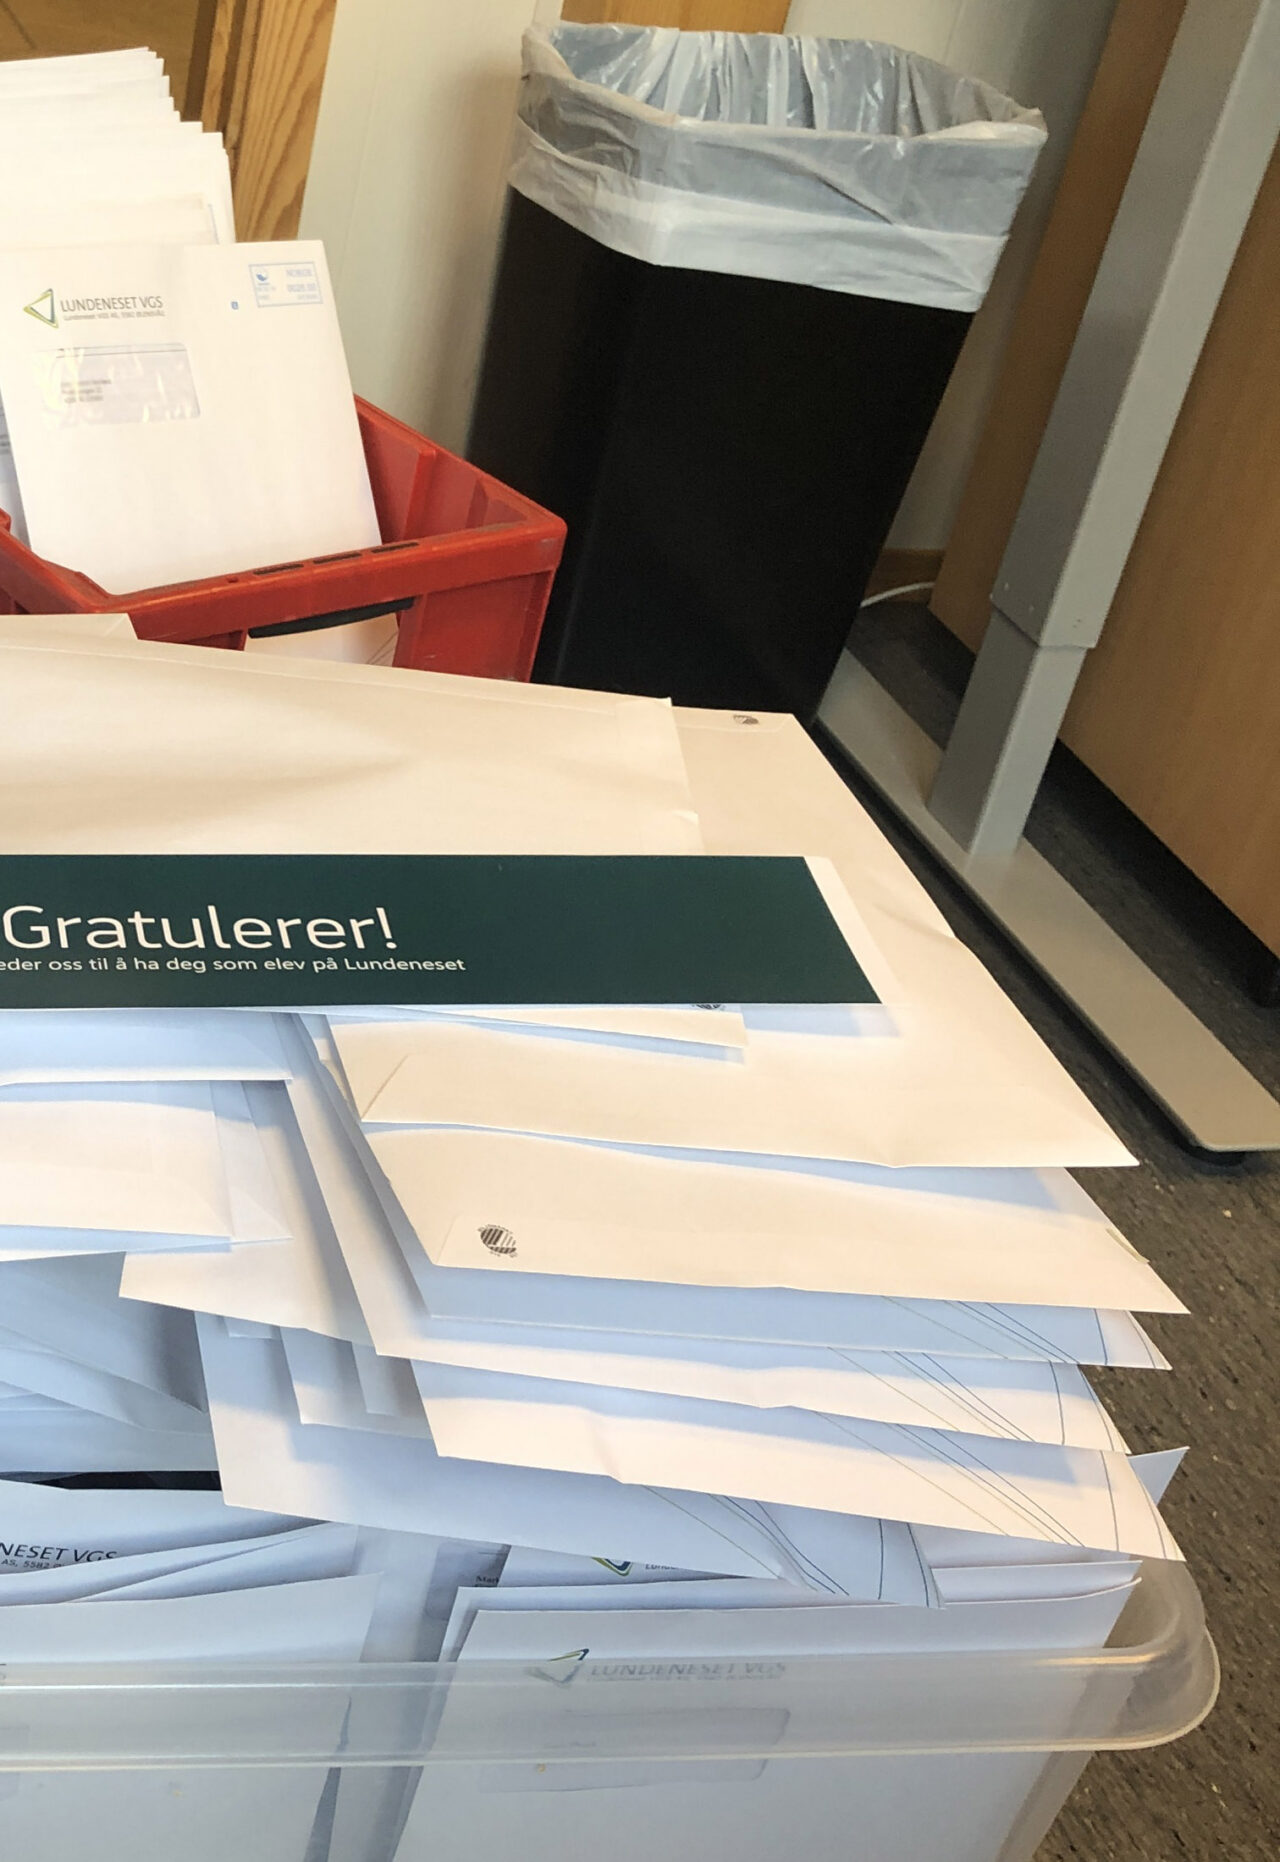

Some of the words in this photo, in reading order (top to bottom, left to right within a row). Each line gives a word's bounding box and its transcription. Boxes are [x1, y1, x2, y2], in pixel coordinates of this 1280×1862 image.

[60, 297, 138, 312] LUNDENESET
[138, 296, 164, 309] VGS
[2, 905, 397, 949] Gratulerer!
[48, 960, 83, 971] oss
[88, 957, 109, 971] til
[115, 957, 128, 971] å
[133, 957, 160, 970] ha
[166, 957, 207, 974] deg
[212, 960, 258, 971] som
[263, 957, 305, 971] elev
[311, 957, 338, 974] på
[343, 957, 467, 971] Lundeneset
[1, 1559, 19, 1568] AS,
[23, 1560, 50, 1569] 5582
